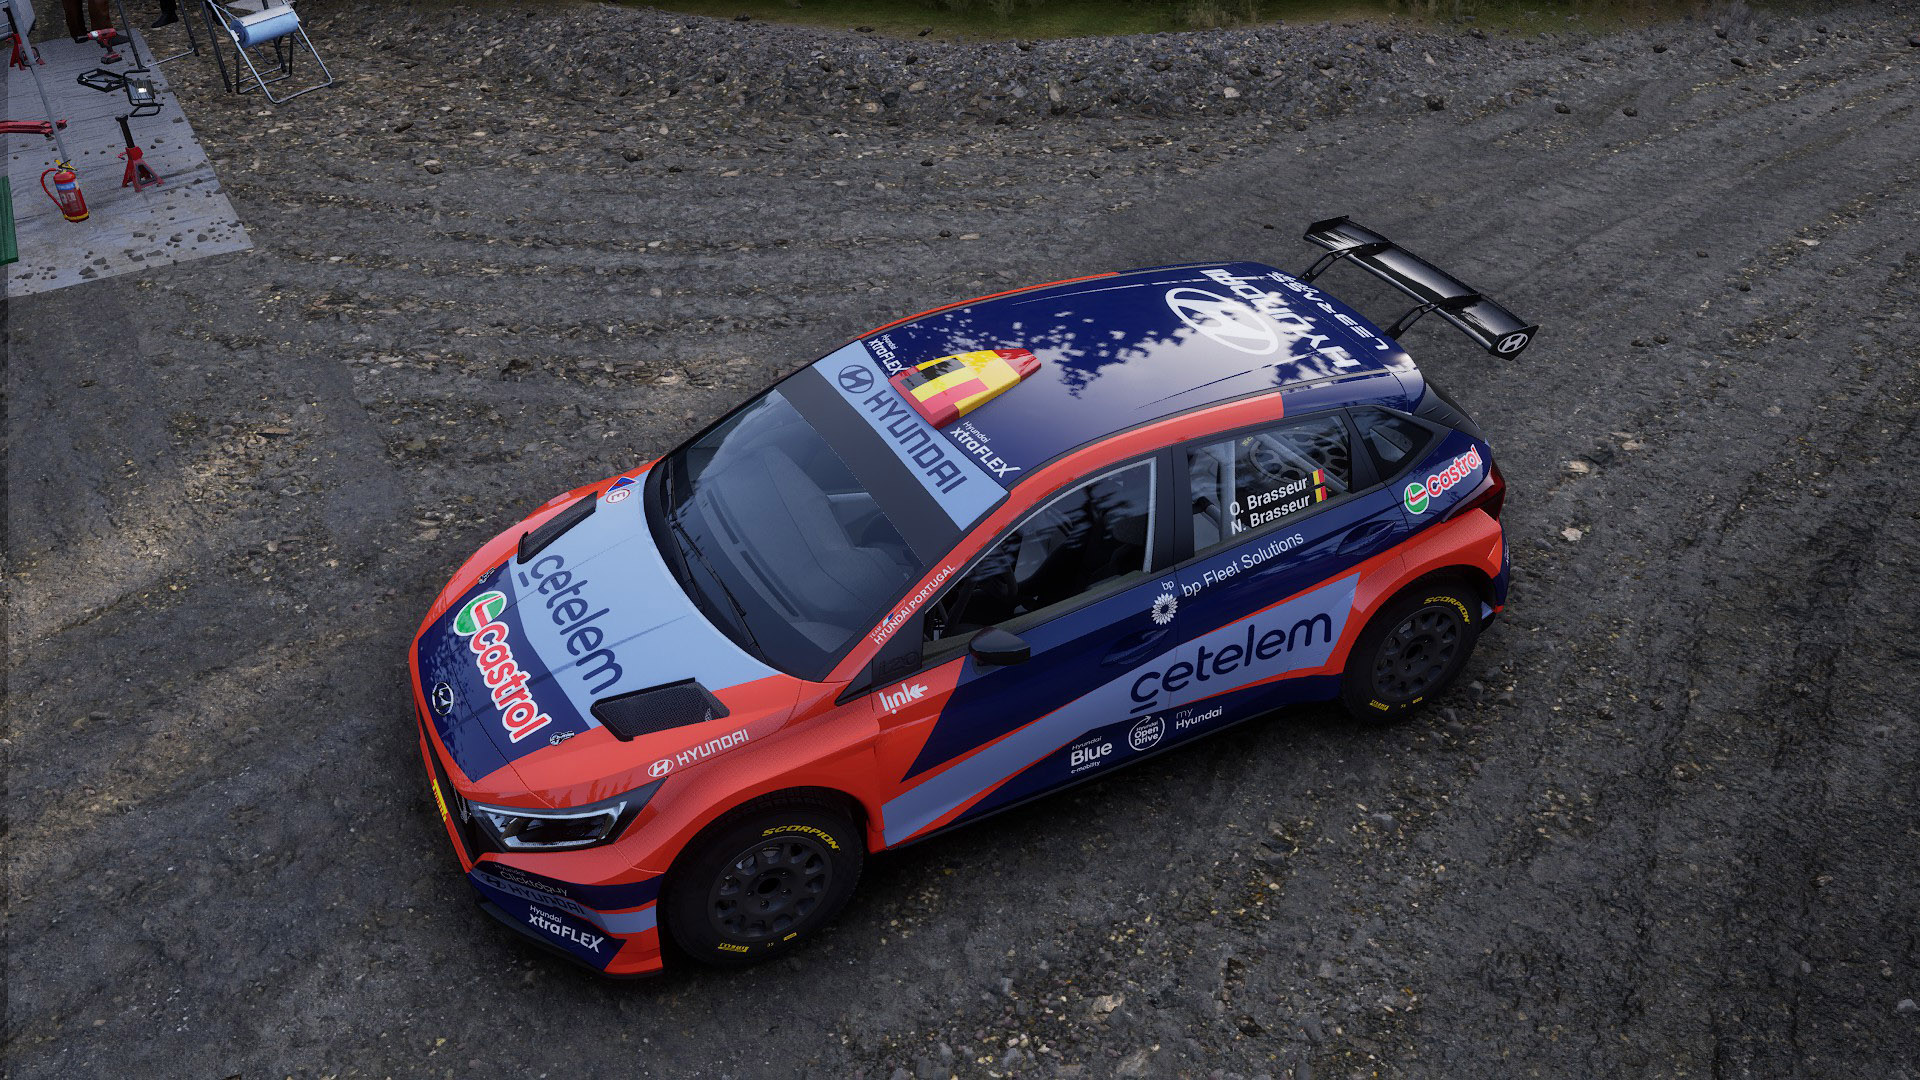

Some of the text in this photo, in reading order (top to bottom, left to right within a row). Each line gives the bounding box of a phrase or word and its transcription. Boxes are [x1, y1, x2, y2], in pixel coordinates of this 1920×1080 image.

[1200, 269, 1361, 367] HYUNDAI
[868, 338, 911, 376] xtraFLEX
[863, 389, 968, 495] HYUNDAI
[963, 421, 991, 443] Hyundai
[950, 427, 1021, 479] xtraFLEX
[1426, 444, 1483, 497] Castrol
[1229, 477, 1308, 516] O. Brasseur
[1230, 495, 1311, 535] N. Brasseur
[1182, 533, 1304, 597] bp Fleet Solutions
[1161, 580, 1175, 591] bp
[873, 565, 956, 645] HYUNDAI PORTUGAL
[1424, 596, 1470, 624] SCORPION
[530, 554, 623, 695] cetelem
[1130, 613, 1332, 703] cetelem
[469, 621, 552, 743] Castrol
[1134, 726, 1158, 739] Open
[1176, 708, 1194, 720] my
[1176, 706, 1223, 729] Hyundai
[676, 728, 749, 766] HYUNDAI
[1071, 743, 1113, 766] Blue
[1134, 733, 1158, 746] Drive
[761, 825, 839, 850] SCORPION
[528, 913, 604, 953] xtraFLEX
[530, 904, 562, 924] Hyundai
